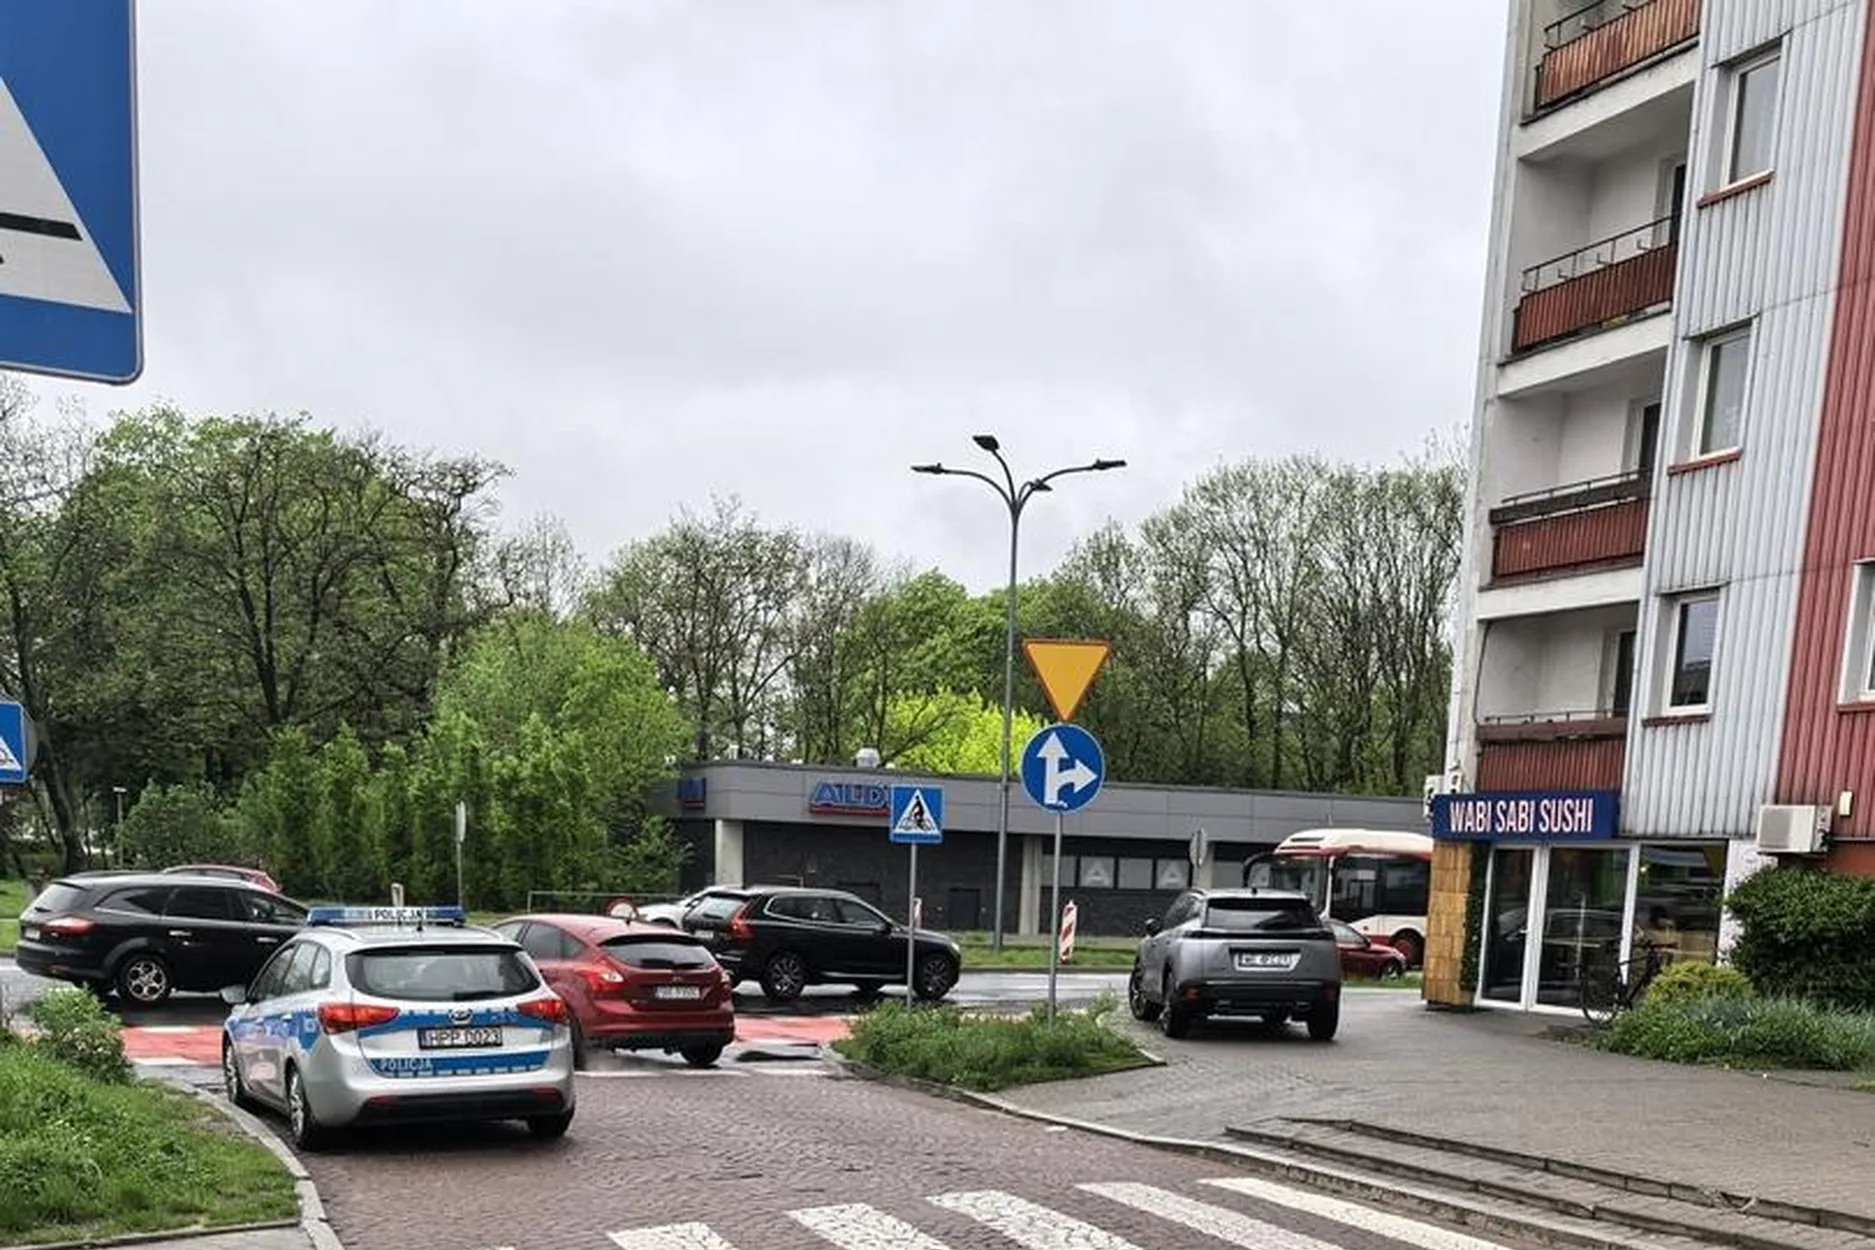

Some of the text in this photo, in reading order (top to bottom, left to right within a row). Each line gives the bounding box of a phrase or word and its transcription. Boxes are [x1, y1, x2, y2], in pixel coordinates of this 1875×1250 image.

[1450, 798, 1593, 832] WABI SABI SUSHI
[374, 909, 422, 920] POLICJA
[379, 1059, 433, 1070] POLICJA
